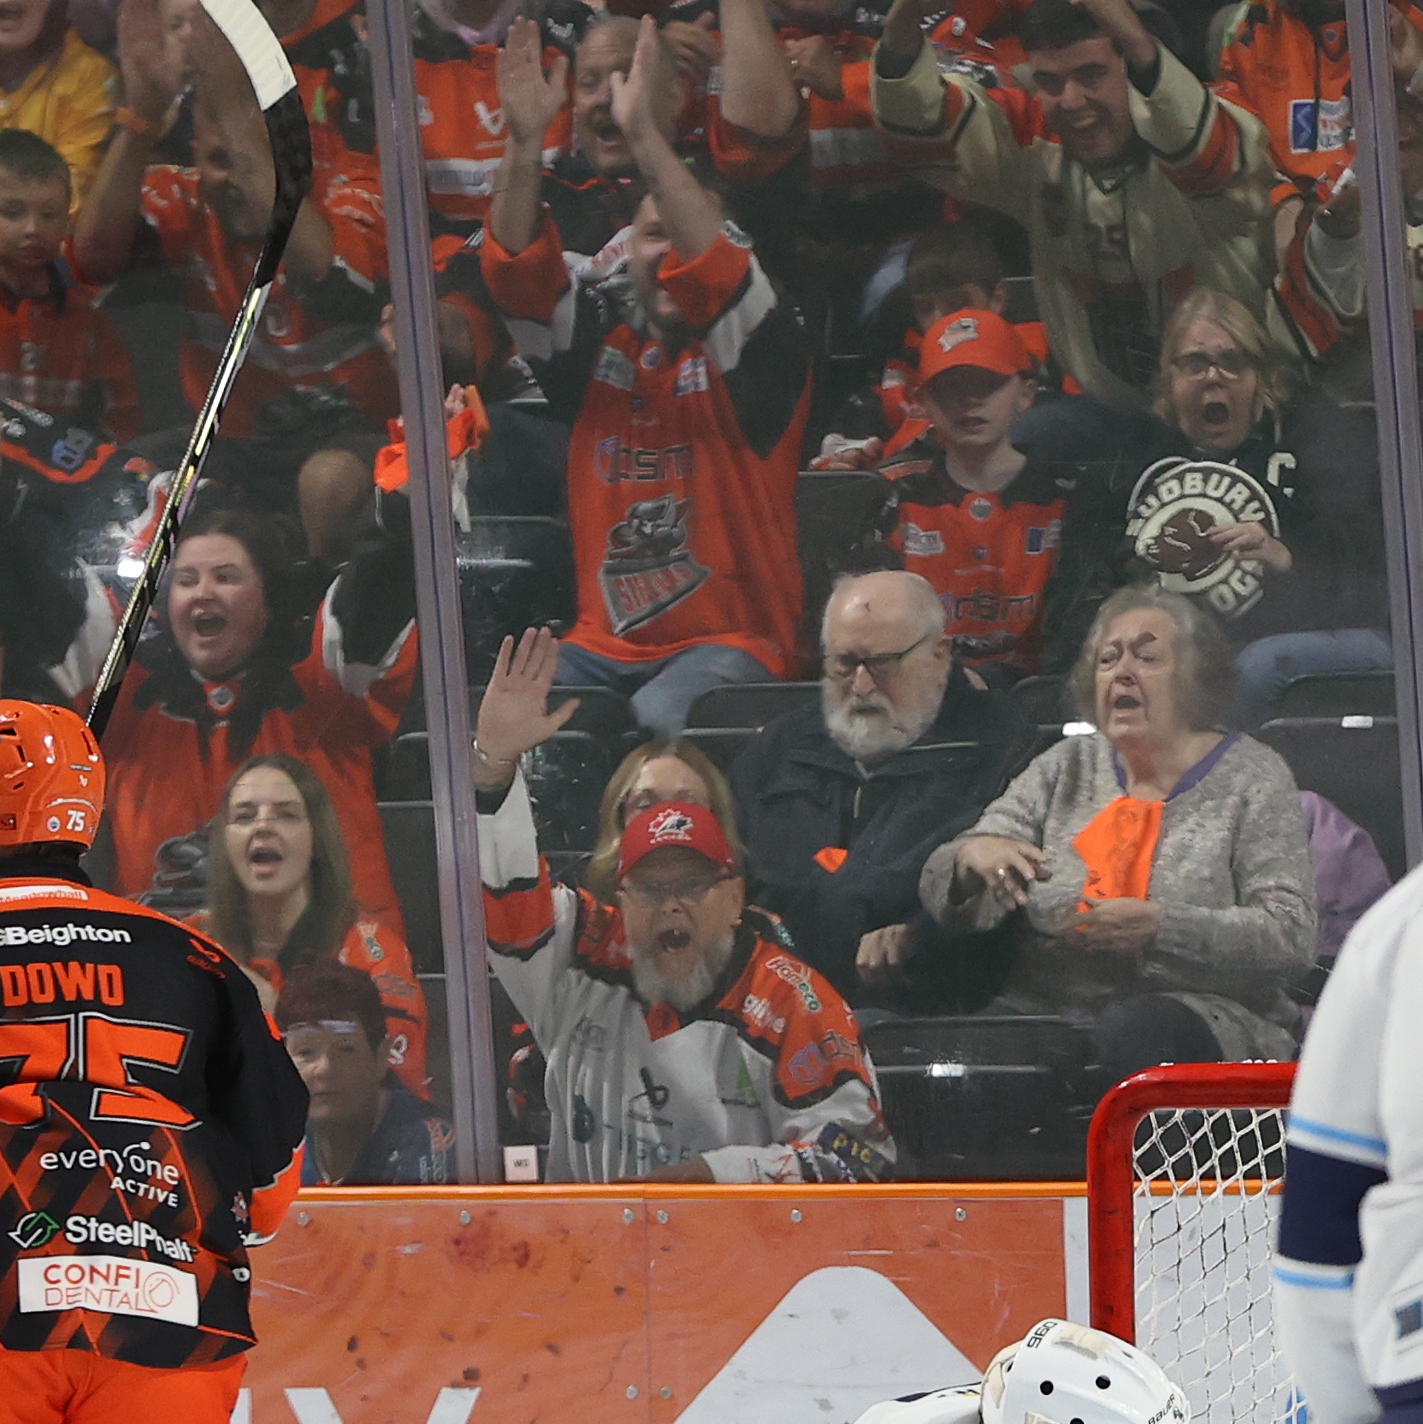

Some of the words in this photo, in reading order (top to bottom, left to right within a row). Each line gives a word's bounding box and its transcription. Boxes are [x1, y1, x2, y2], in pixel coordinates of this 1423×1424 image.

[67, 811, 86, 832] 75
[39, 1141, 181, 1186] everyone
[110, 1175, 179, 1208] ACTIVE
[65, 1215, 195, 1263] SteelPhalt
[44, 1262, 141, 1286] CONFI
[44, 1286, 159, 1313] DENTAL
